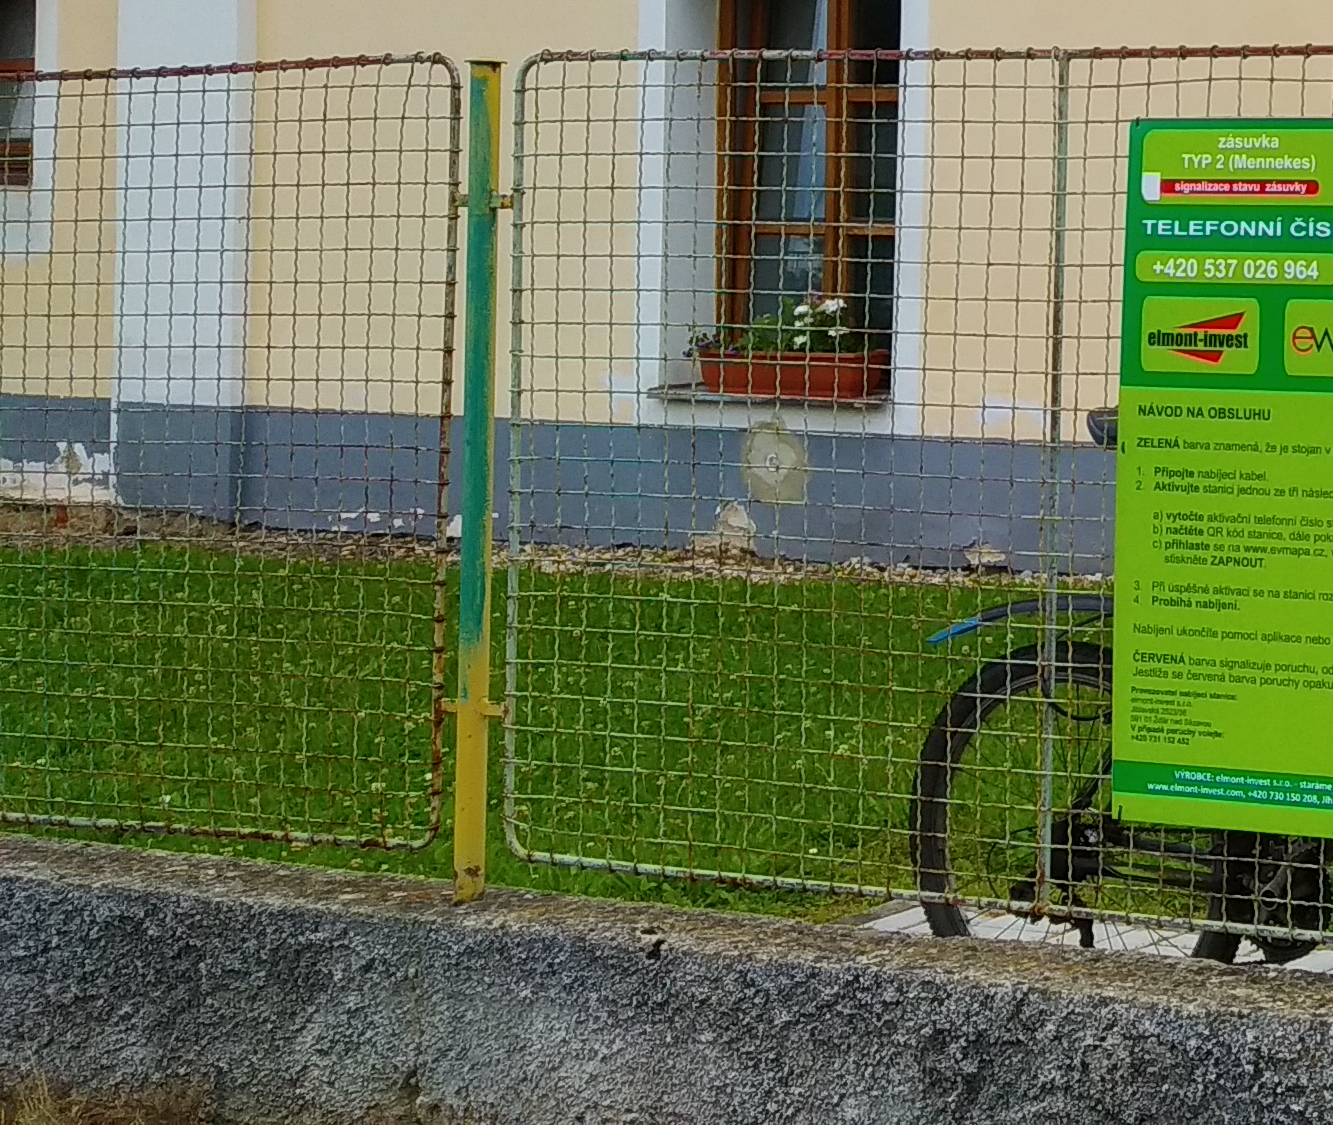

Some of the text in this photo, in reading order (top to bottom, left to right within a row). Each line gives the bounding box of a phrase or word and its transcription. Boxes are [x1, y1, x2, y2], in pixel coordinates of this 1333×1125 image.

[1217, 133, 1279, 150] zásuvka
[1181, 153, 1316, 171] TYP 2 (Mennekes)
[1174, 180, 1307, 195] signalizace stavu zásuvky
[1141, 217, 1282, 236] TELEFONNÍ
[1152, 258, 1319, 280] +420 537 026 964
[1147, 328, 1249, 350] elmont-invest
[1137, 401, 1271, 421] NÁVOD NA OBSLUHU
[1135, 435, 1180, 449] ZELENÁ
[1182, 438, 1211, 450] barva
[1264, 441, 1277, 453] že
[1278, 443, 1289, 455] je
[1290, 443, 1322, 457] stojan
[1323, 446, 1331, 454] v
[1153, 465, 1195, 480] Připojte
[1238, 469, 1268, 481] kabel.
[1152, 480, 1200, 495] Aktivujte
[1202, 483, 1234, 495] stanici
[1236, 484, 1271, 497] jednou
[1272, 487, 1286, 497] ze
[1152, 509, 1163, 522] a)
[1164, 510, 1204, 523] vytočte
[1152, 523, 1163, 537] b)
[1206, 525, 1224, 537] QR
[1225, 526, 1244, 538] kód
[1288, 530, 1311, 542] dále
[1151, 537, 1162, 550] c)
[1163, 538, 1210, 551] přihlaste
[1210, 542, 1225, 552] se
[1227, 543, 1241, 553] na
[1163, 553, 1208, 565] stiskněte
[1150, 580, 1165, 592] Při
[1211, 584, 1250, 597] aktivaci
[1252, 588, 1265, 597] se
[1266, 589, 1280, 598] na
[1282, 588, 1316, 600] stanici
[1150, 595, 1192, 608] Probíhá
[1260, 630, 1302, 644] aplikace
[1304, 634, 1331, 645] nebo
[1132, 649, 1186, 665] ČERVENÁ
[1188, 655, 1216, 667] barva
[1218, 657, 1272, 673] signalizuje
[1273, 662, 1318, 675] poruchu,
[1170, 669, 1184, 680] se
[1185, 668, 1226, 682] červená
[1228, 672, 1257, 685] barva
[1258, 675, 1300, 689] poruchy
[1173, 769, 1214, 782] VÝROBCE:
[1214, 773, 1271, 786] elmont-invest
[1298, 780, 1332, 791] staráme
[1247, 789, 1268, 799] +420
[1268, 790, 1284, 801] 730
[1285, 792, 1301, 802] 150
[1301, 793, 1320, 805] 208,
